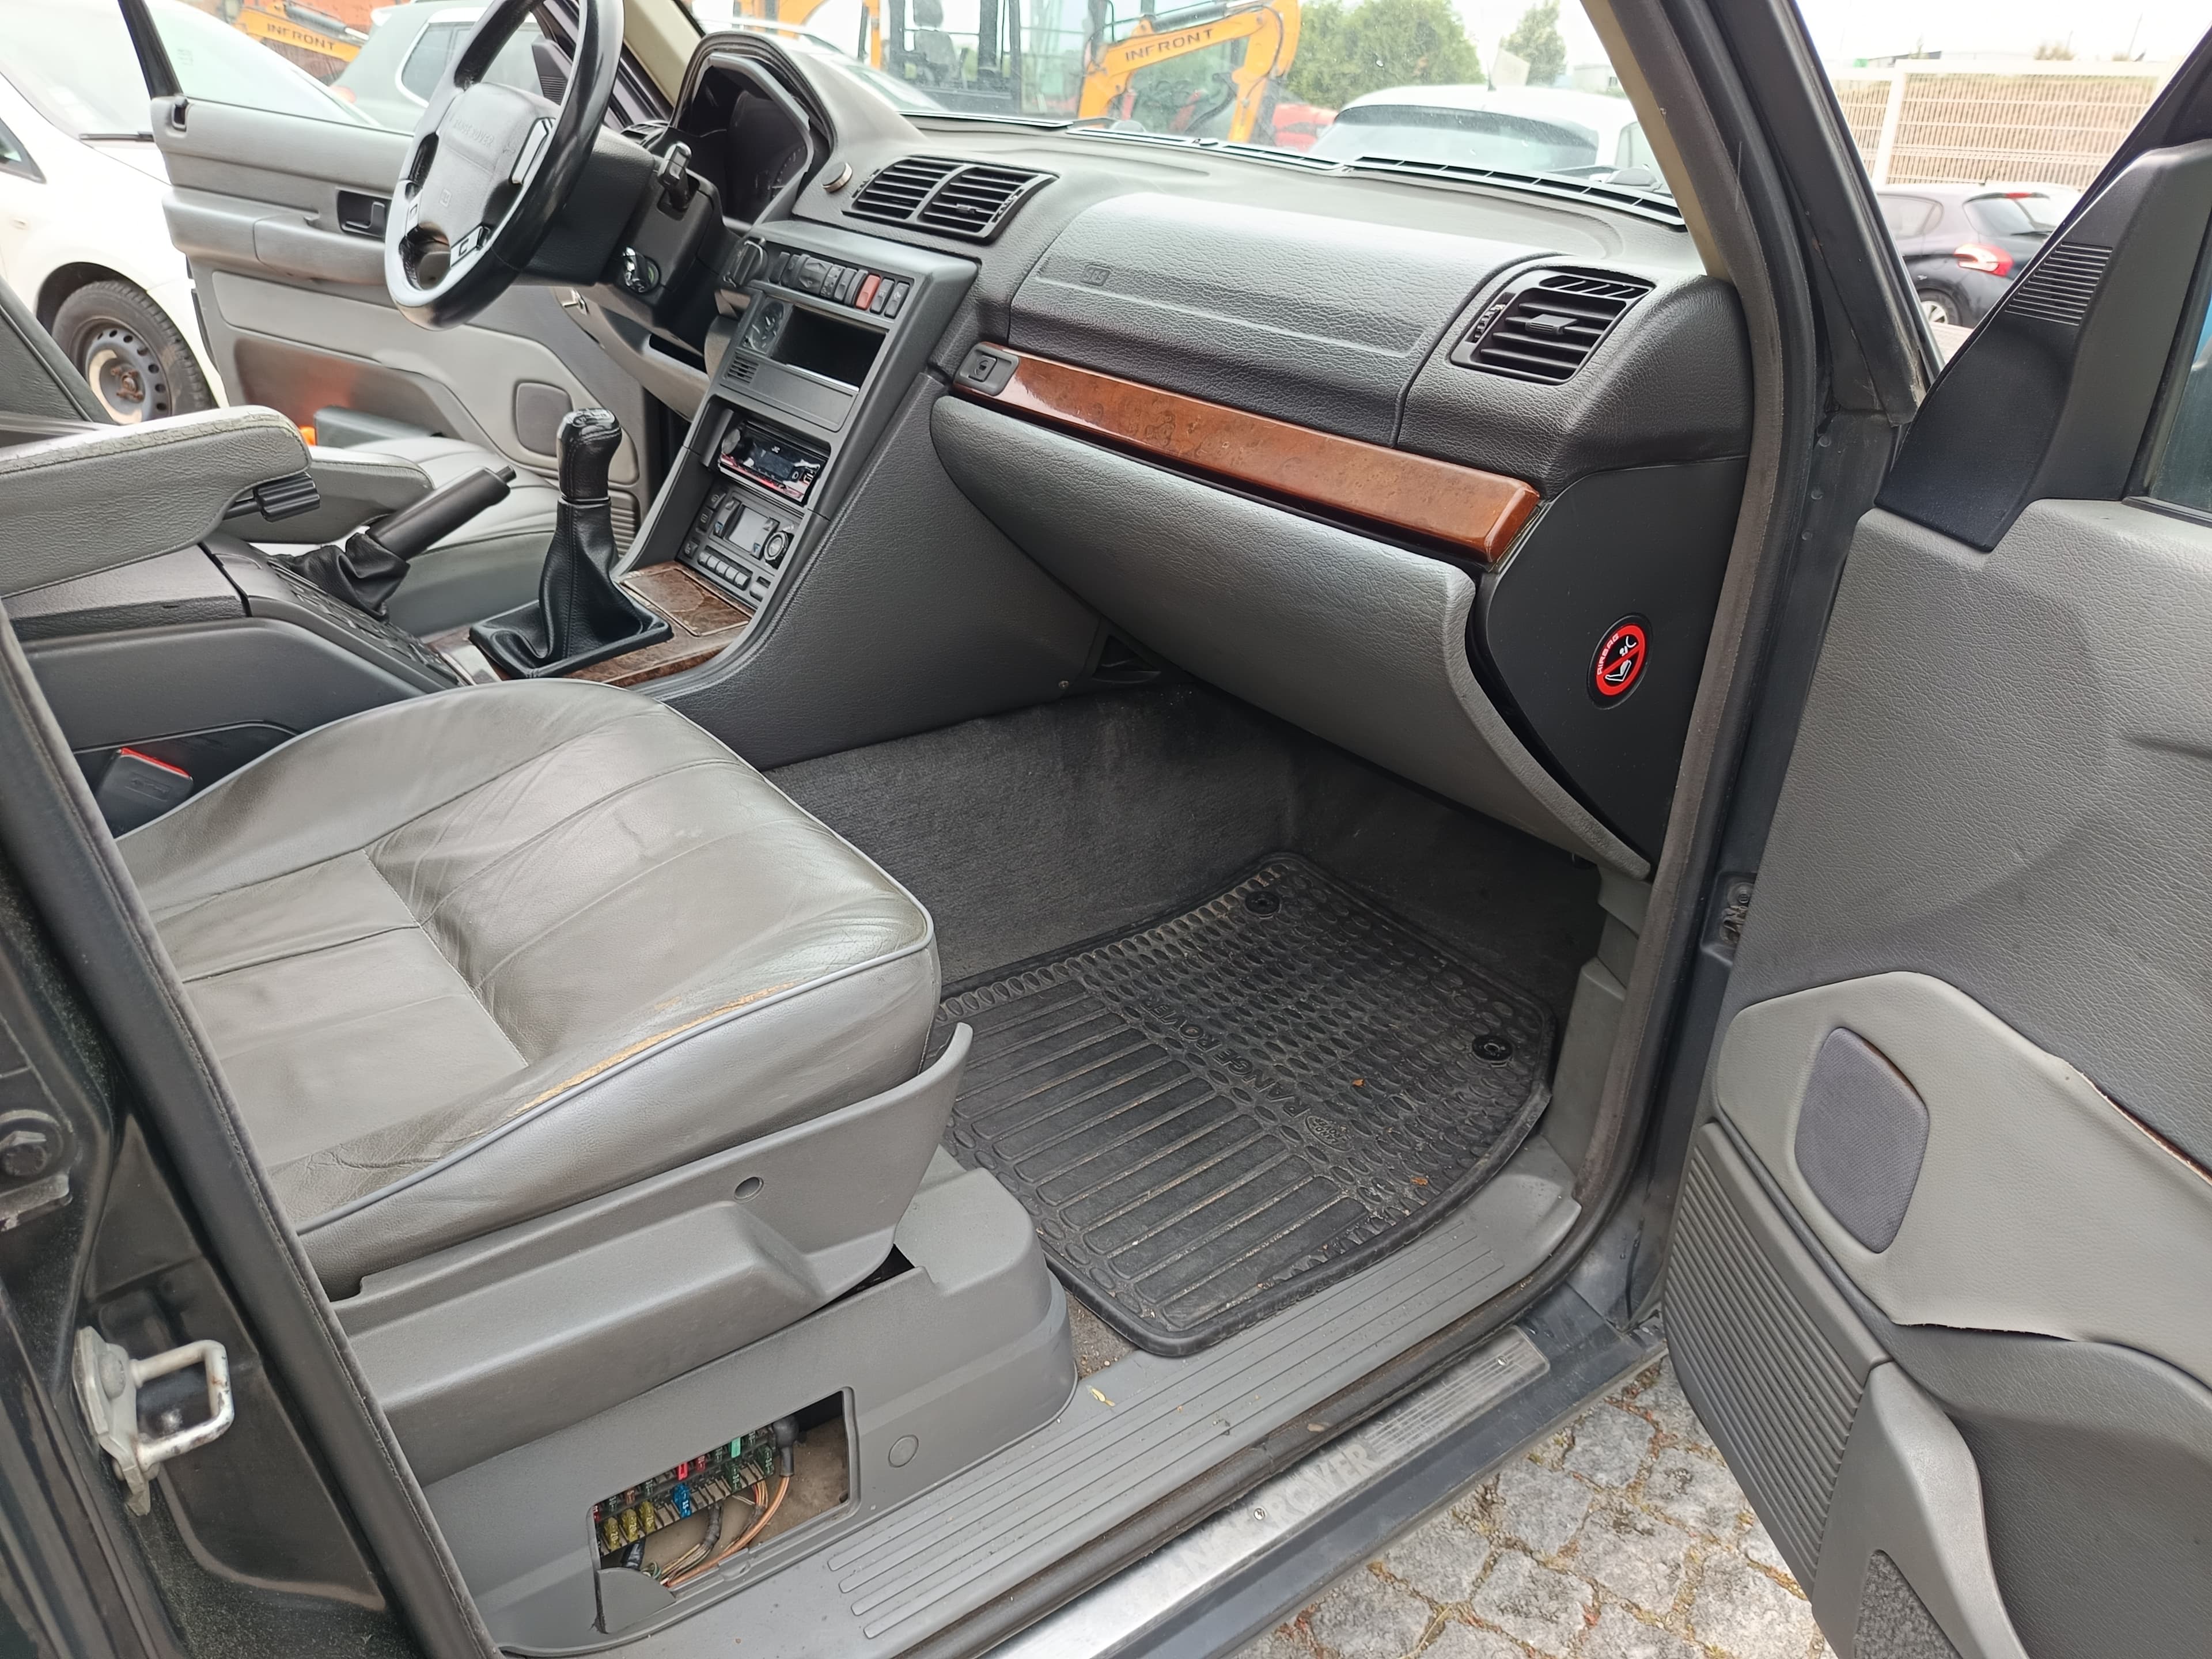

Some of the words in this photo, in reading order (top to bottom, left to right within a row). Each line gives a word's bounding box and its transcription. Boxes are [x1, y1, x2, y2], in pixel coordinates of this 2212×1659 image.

[267, 22, 335, 50] INFRONT
[1126, 28, 1214, 62] INFRONT
[1082, 268, 1107, 284] SRS
[1596, 632, 1619, 675] AIRBAG
[1213, 1047, 1310, 1118] RANGE
[1270, 1443, 1379, 1532] ROVER
[610, 1532, 619, 1541] 20
